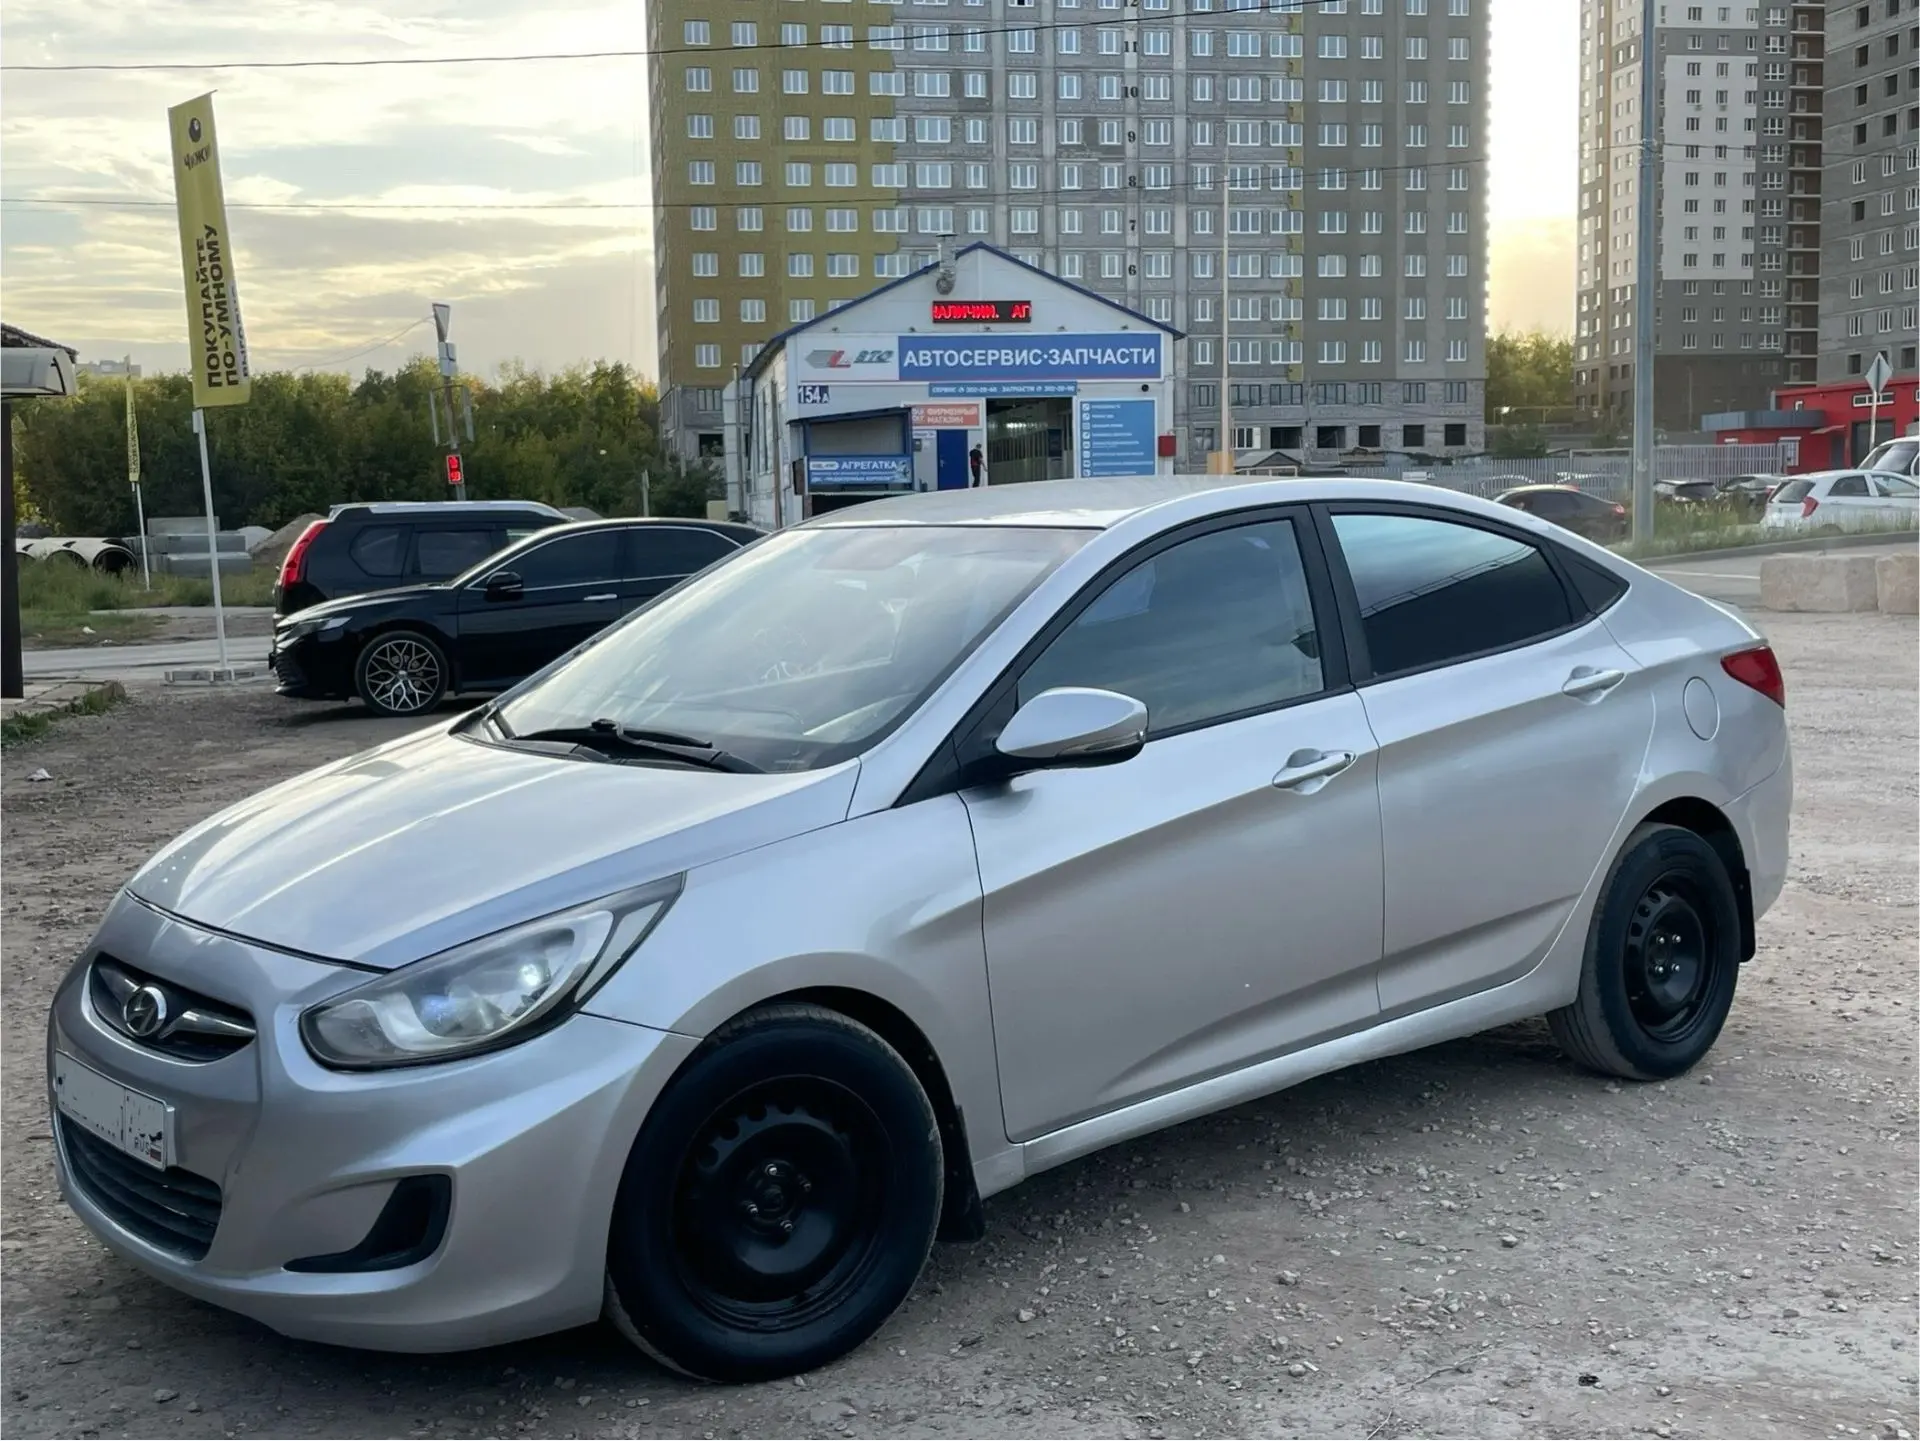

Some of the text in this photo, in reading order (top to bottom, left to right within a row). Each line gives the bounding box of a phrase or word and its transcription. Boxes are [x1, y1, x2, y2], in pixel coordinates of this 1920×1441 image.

[1123, 41, 1138, 53] 11
[1122, 86, 1139, 98] 10
[1127, 131, 1136, 143] 9
[1128, 175, 1137, 188] 8
[1128, 219, 1137, 231] 7
[1128, 264, 1137, 276] 6
[204, 224, 240, 386] ПО-УМНОМУ
[196, 238, 223, 388] ПОКУПАЙТЕ
[841, 460, 898, 470] АГРЕГАТКА
